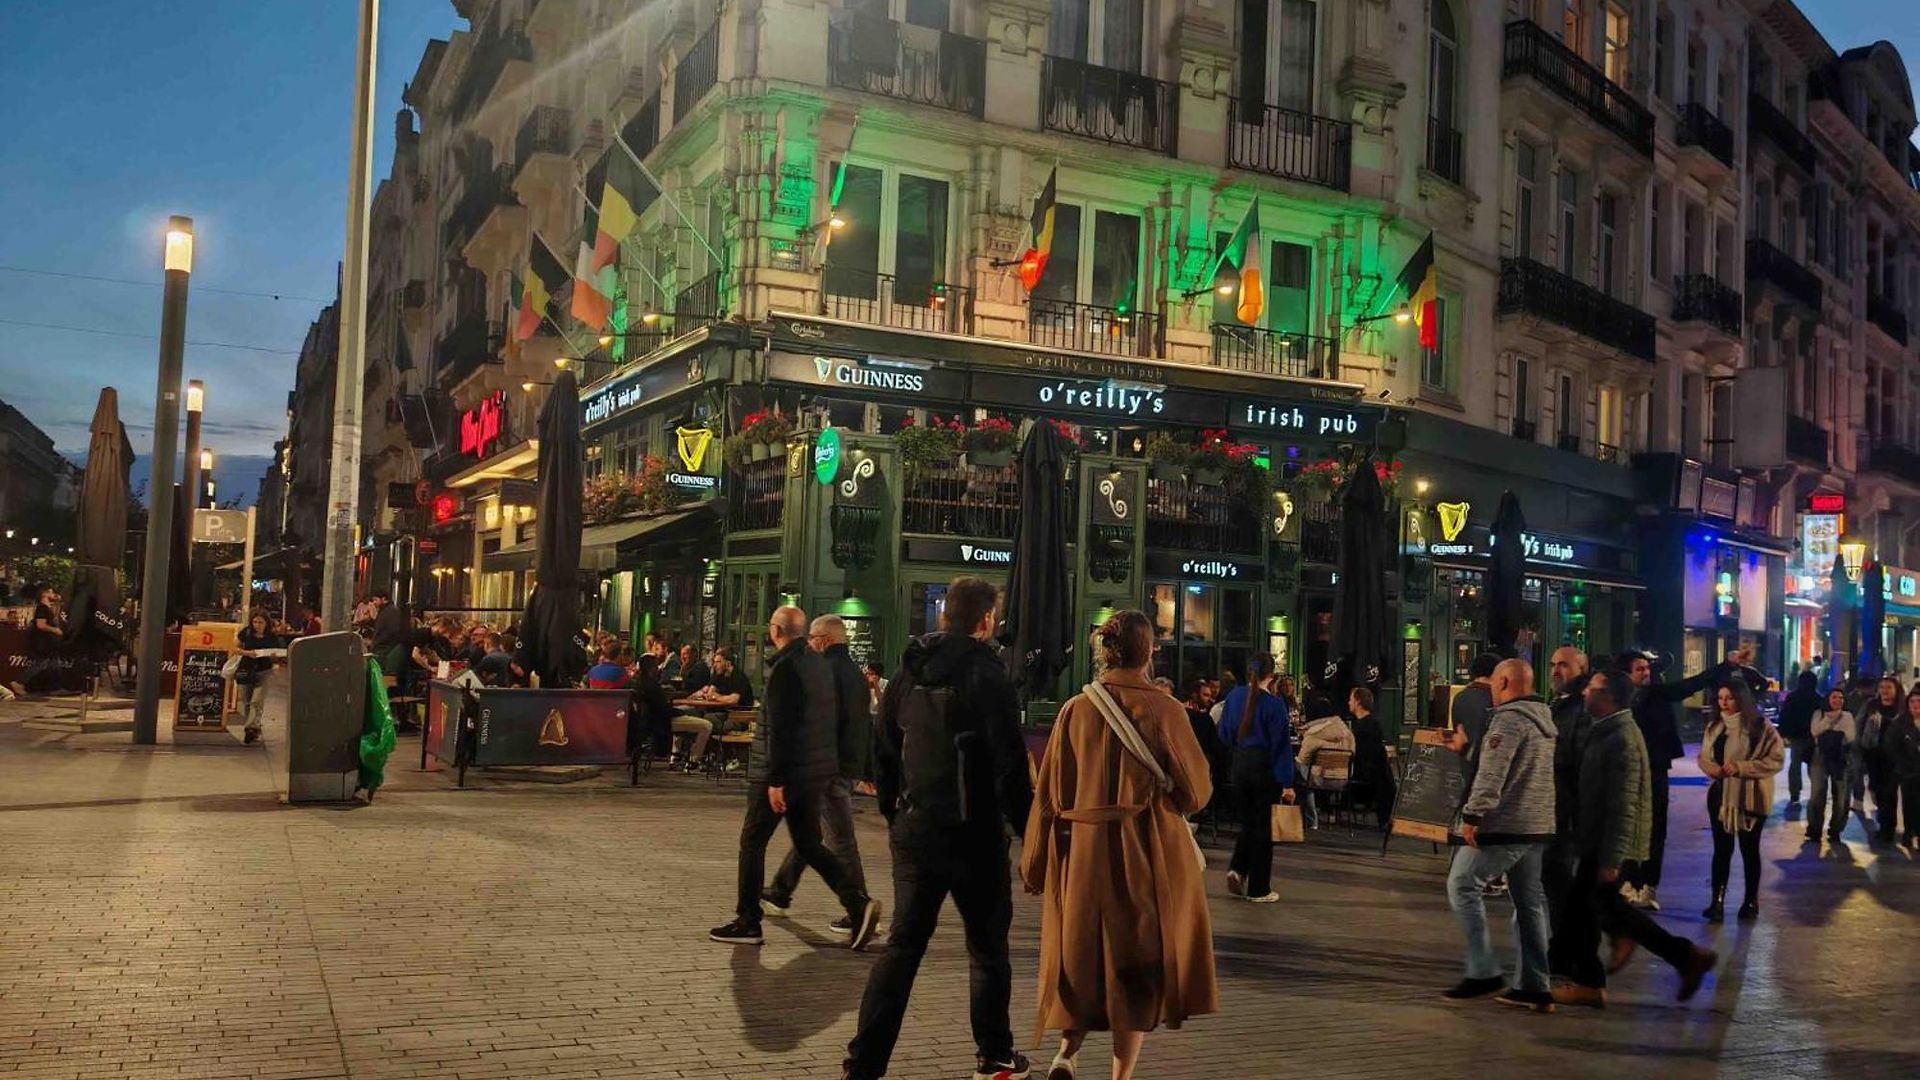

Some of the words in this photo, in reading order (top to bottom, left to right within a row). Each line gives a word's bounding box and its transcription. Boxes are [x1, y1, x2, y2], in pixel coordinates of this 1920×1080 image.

[835, 364, 923, 392] GUINNESS
[1039, 382, 1164, 415] o'reilly's
[1247, 405, 1303, 428] irish
[1320, 414, 1357, 435] pub
[670, 473, 714, 487] GUINNESS
[974, 549, 1011, 562] GUINN
[1183, 560, 1237, 577] o'reilly's
